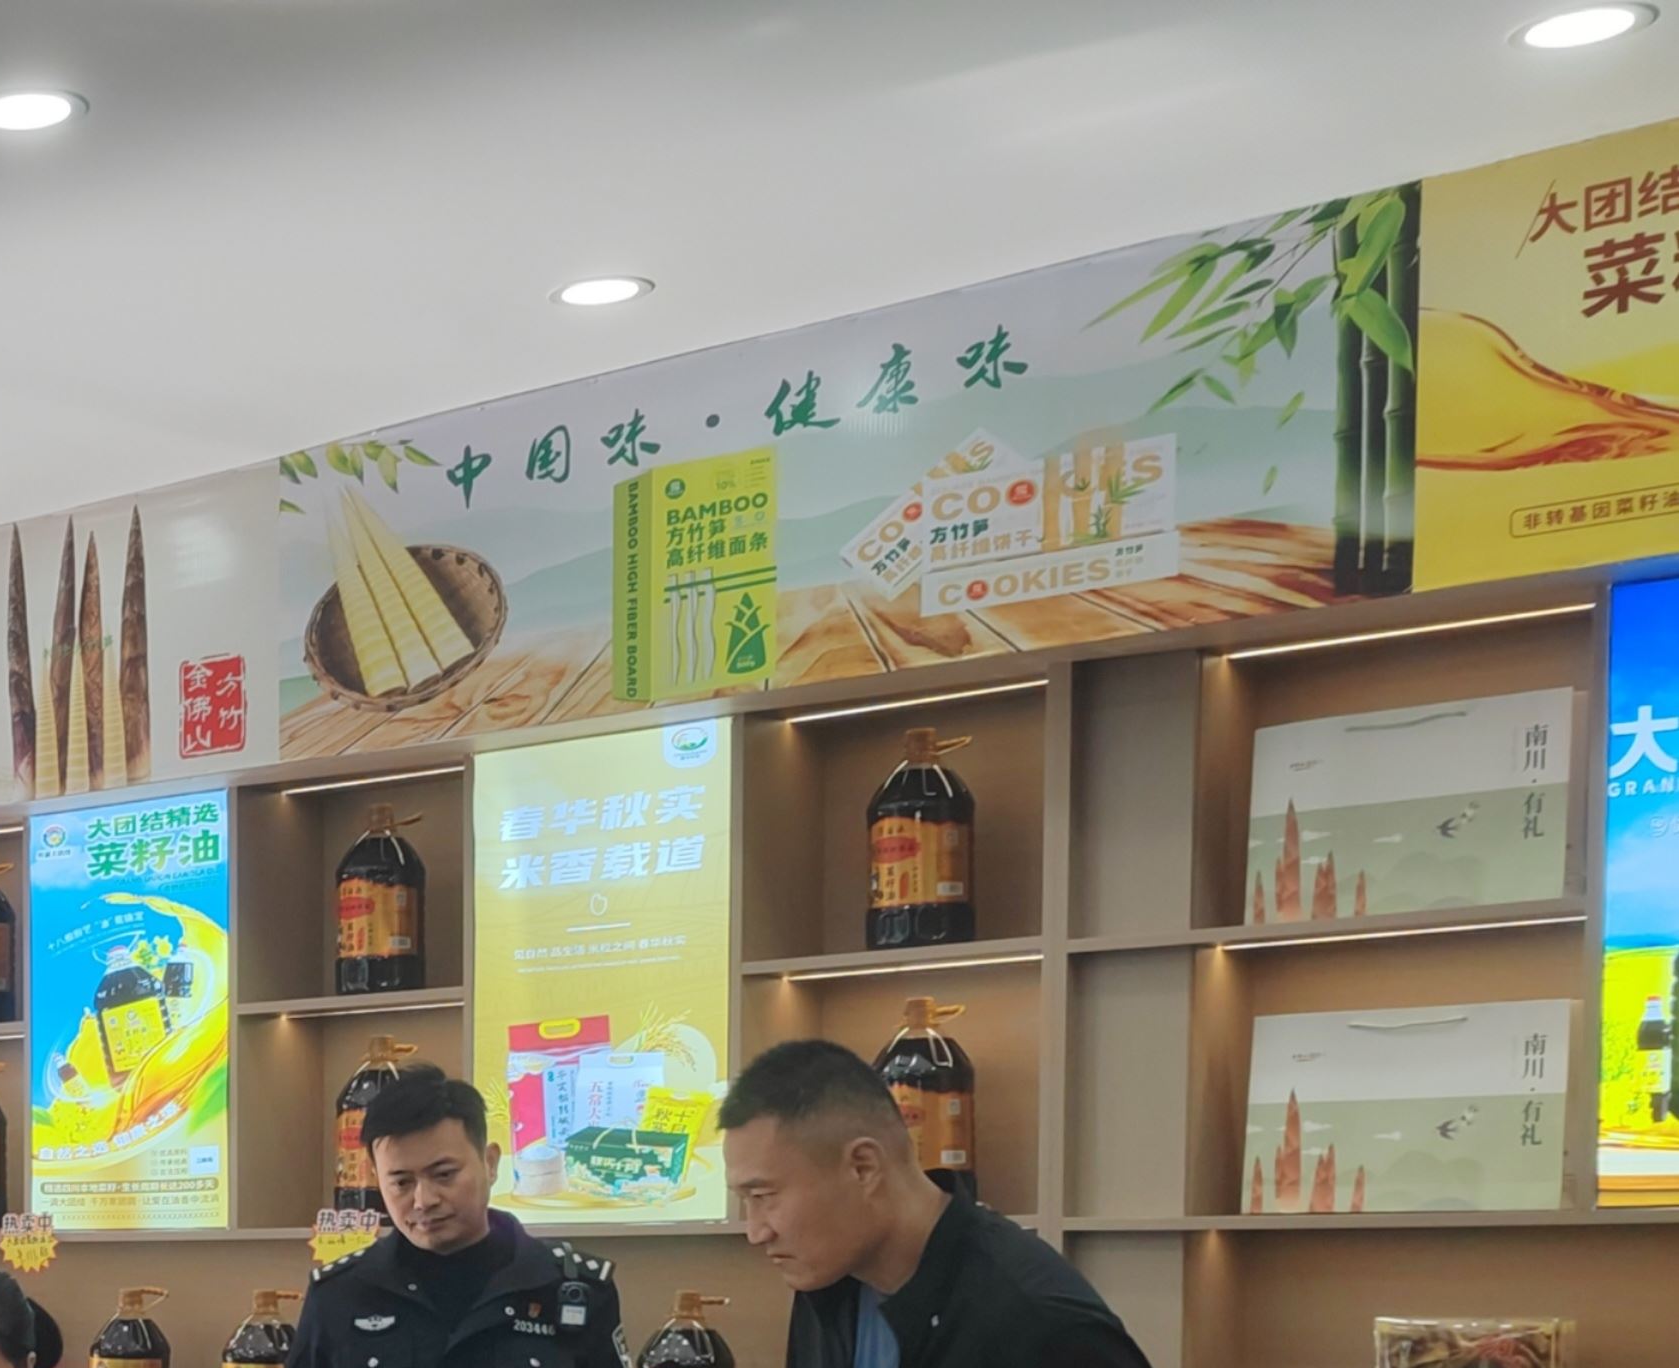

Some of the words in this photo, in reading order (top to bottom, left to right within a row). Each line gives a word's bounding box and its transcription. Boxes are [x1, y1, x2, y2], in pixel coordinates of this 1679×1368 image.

[1581, 230, 1679, 318] 菜
[447, 409, 660, 509] 中国味
[765, 324, 1028, 436] 健康味
[628, 481, 639, 549] BAMBOO
[666, 492, 769, 526] BAMBOO
[666, 518, 727, 548] 方竹笋
[666, 531, 769, 569] 高纤维面条
[929, 518, 990, 545] 方竹笋
[627, 554, 638, 593] HIGH
[627, 597, 638, 641] FIBER
[626, 645, 638, 698] BOARD
[1608, 777, 1679, 797] GRAN
[87, 803, 220, 840] 大团结精选
[498, 785, 707, 843] 春华秋实
[87, 829, 220, 877] 菜籽油
[498, 834, 707, 891] 米香载道
[3, 1212, 52, 1234] 热卖中
[317, 1209, 379, 1233] 热卖中
